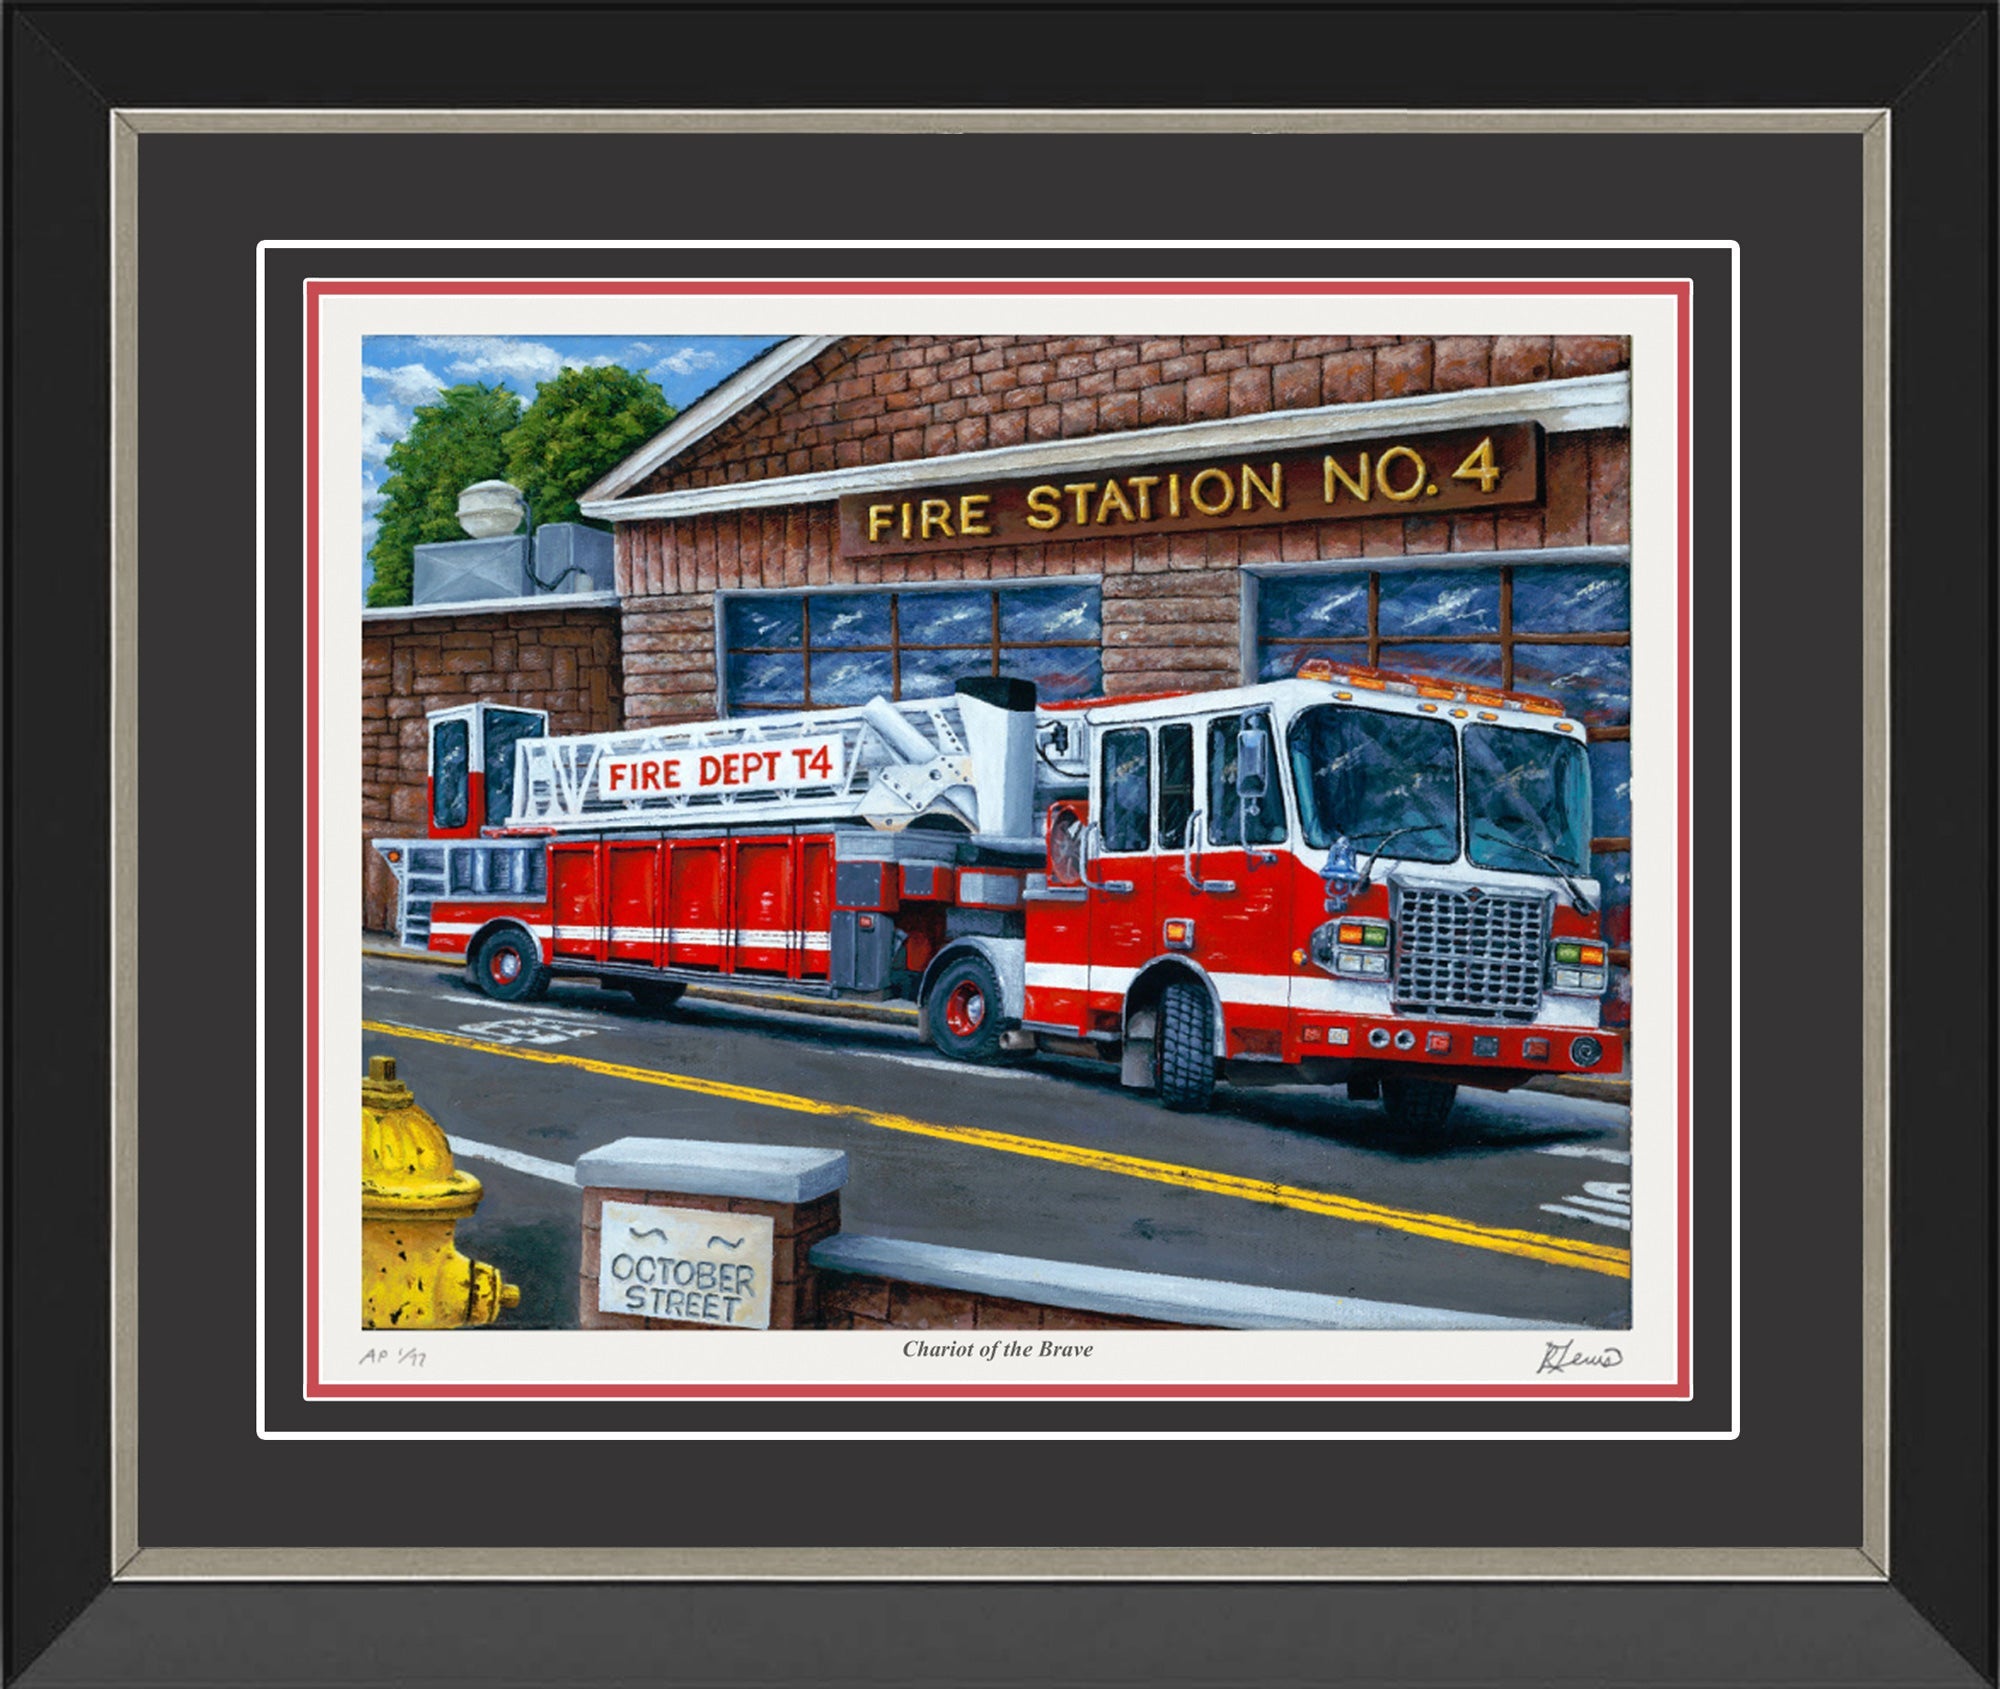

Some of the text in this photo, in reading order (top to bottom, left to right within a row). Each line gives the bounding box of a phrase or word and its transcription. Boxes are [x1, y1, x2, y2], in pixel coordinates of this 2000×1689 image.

[867, 437, 1499, 541] FIRE STATION NO. 4
[609, 744, 834, 791] FIRE DEPT T4
[611, 1253, 755, 1297] OCTOBER
[626, 1284, 742, 1323] STREET
[903, 1340, 1094, 1361] Chariot of the Brave
